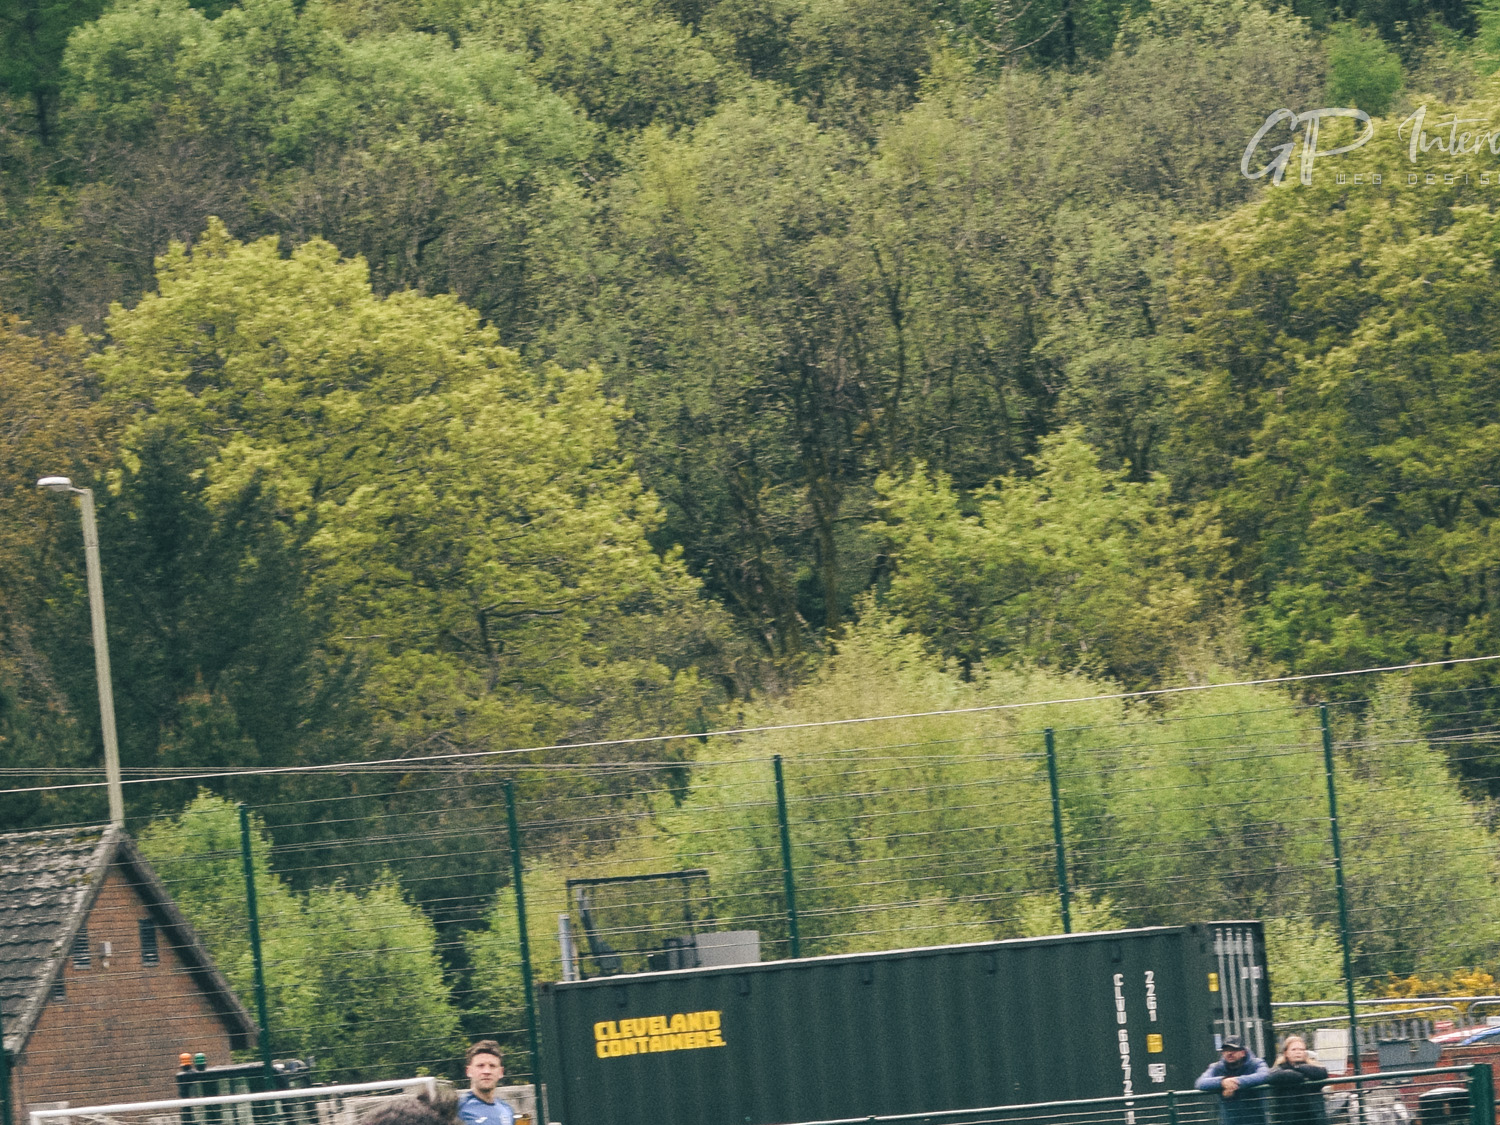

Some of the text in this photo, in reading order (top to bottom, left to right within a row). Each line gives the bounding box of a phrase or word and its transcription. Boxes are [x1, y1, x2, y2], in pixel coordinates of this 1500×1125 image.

[1113, 973, 1127, 1024] CLVU
[1144, 970, 1157, 1021] 22G1
[593, 1010, 722, 1041] CLEVELAND
